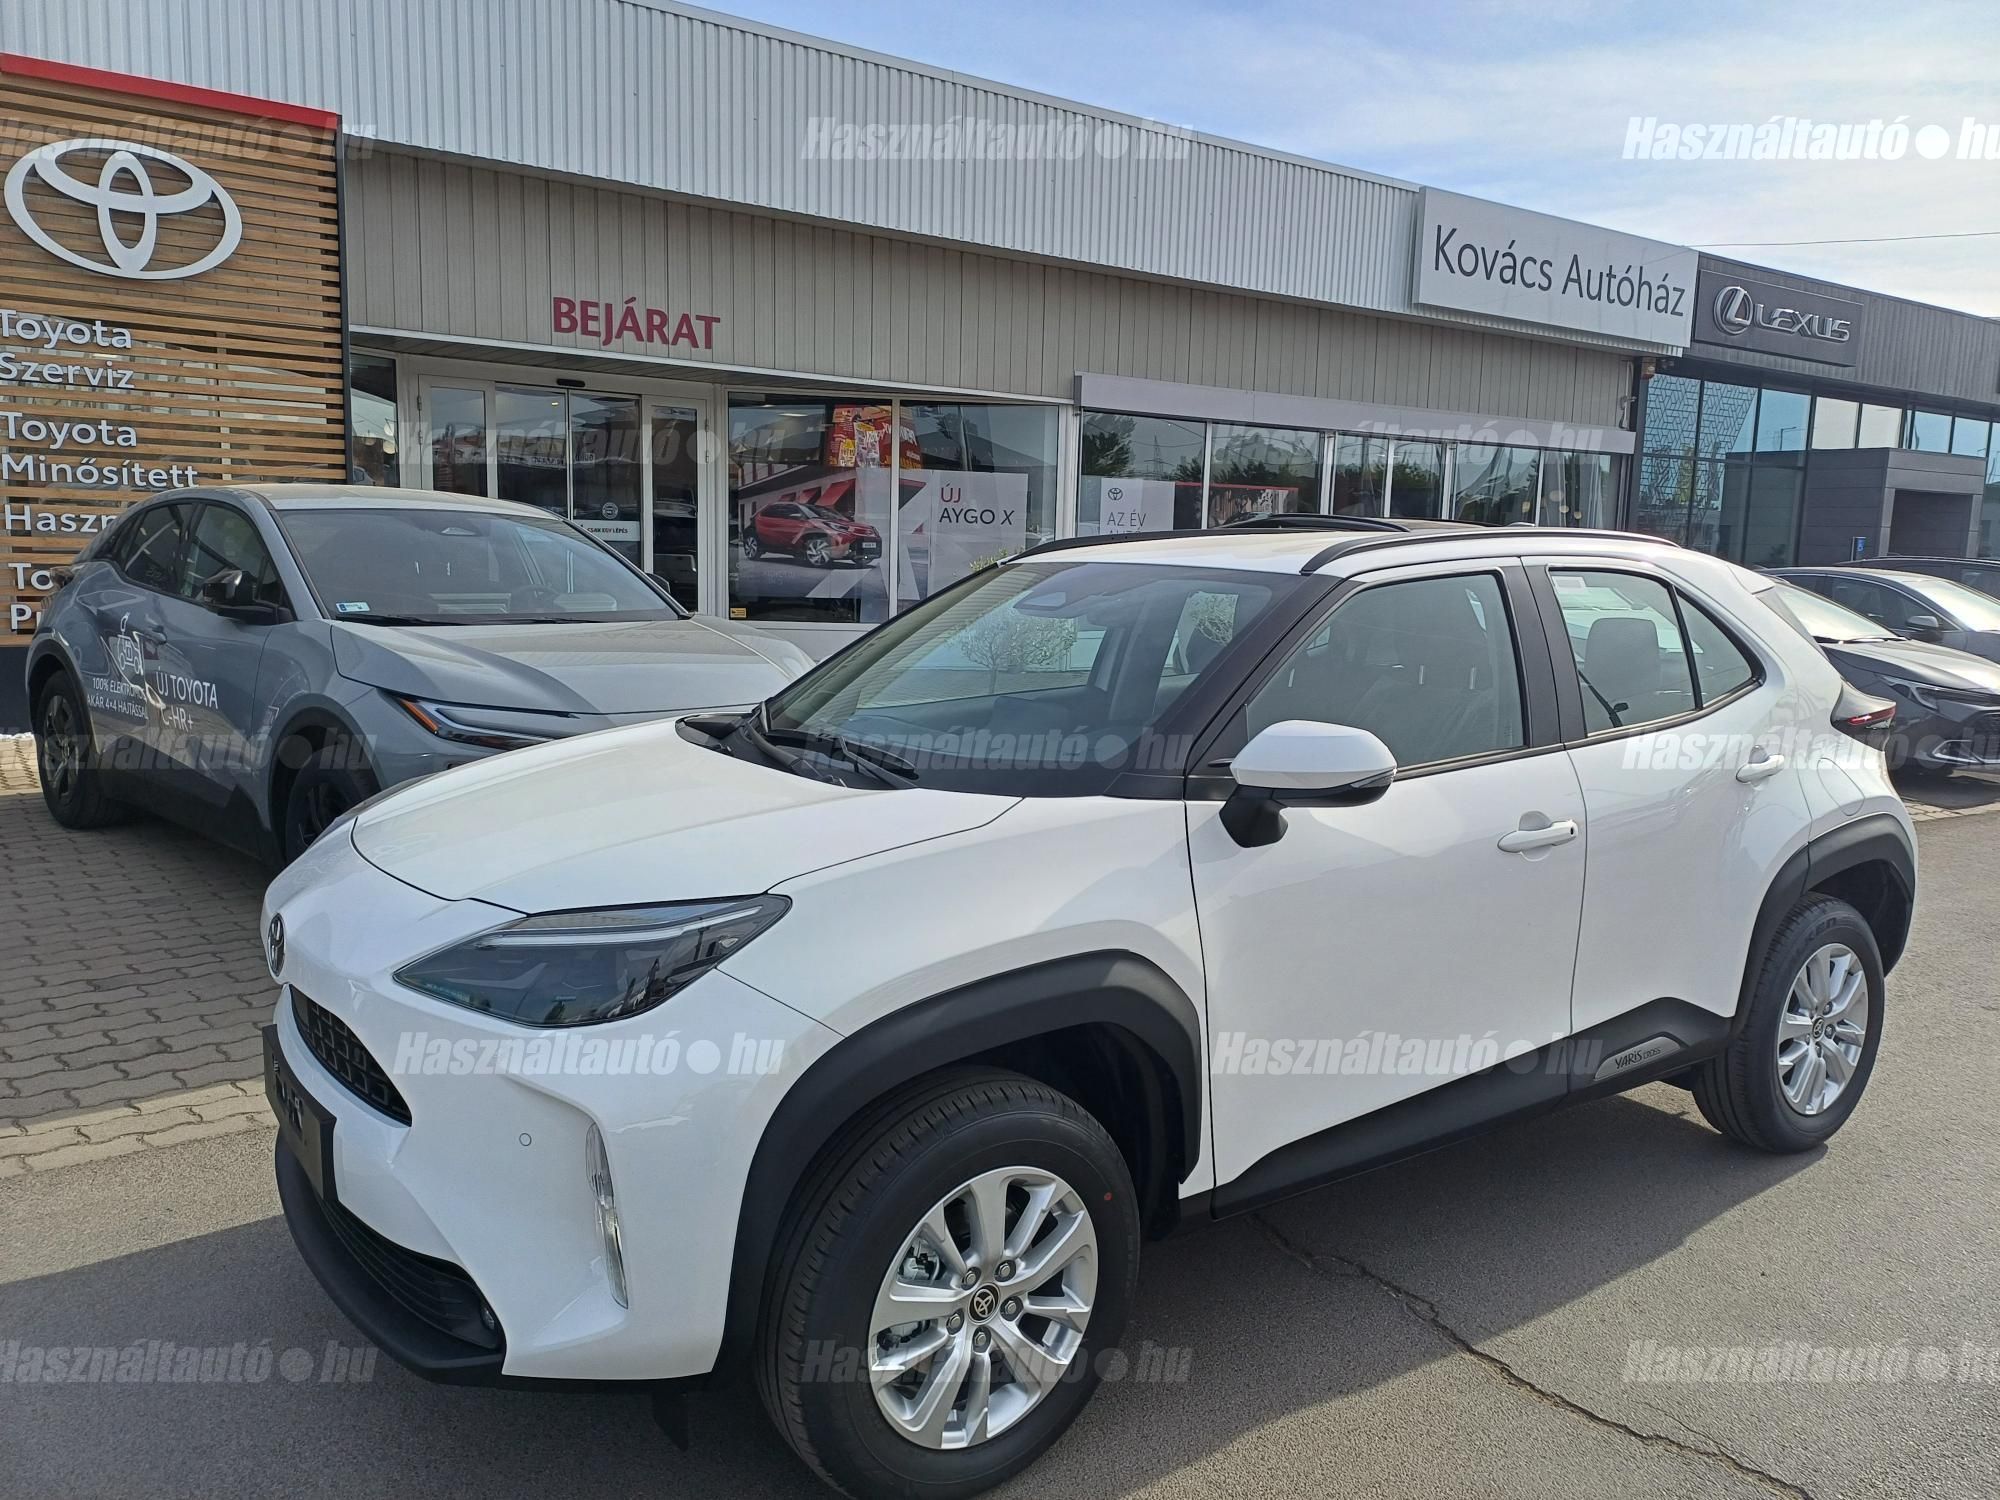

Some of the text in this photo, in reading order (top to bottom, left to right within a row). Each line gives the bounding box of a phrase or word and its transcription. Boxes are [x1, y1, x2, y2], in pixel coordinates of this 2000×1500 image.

[1434, 224, 1686, 317] Kovács Autóház
[0, 309, 132, 349] Toyota
[553, 296, 721, 350] BEJÁRAT
[1754, 303, 1851, 343] LEXUS
[0, 352, 135, 389] Szerviz
[0, 411, 137, 450] Toyota
[1, 453, 200, 488] Minősített
[941, 482, 961, 503] ÚJ
[939, 507, 1015, 525] AYGO X
[1107, 508, 1147, 527] AZ ÉV
[93, 677, 109, 691] 100%
[155, 666, 219, 709] ÚJ TOYOTA
